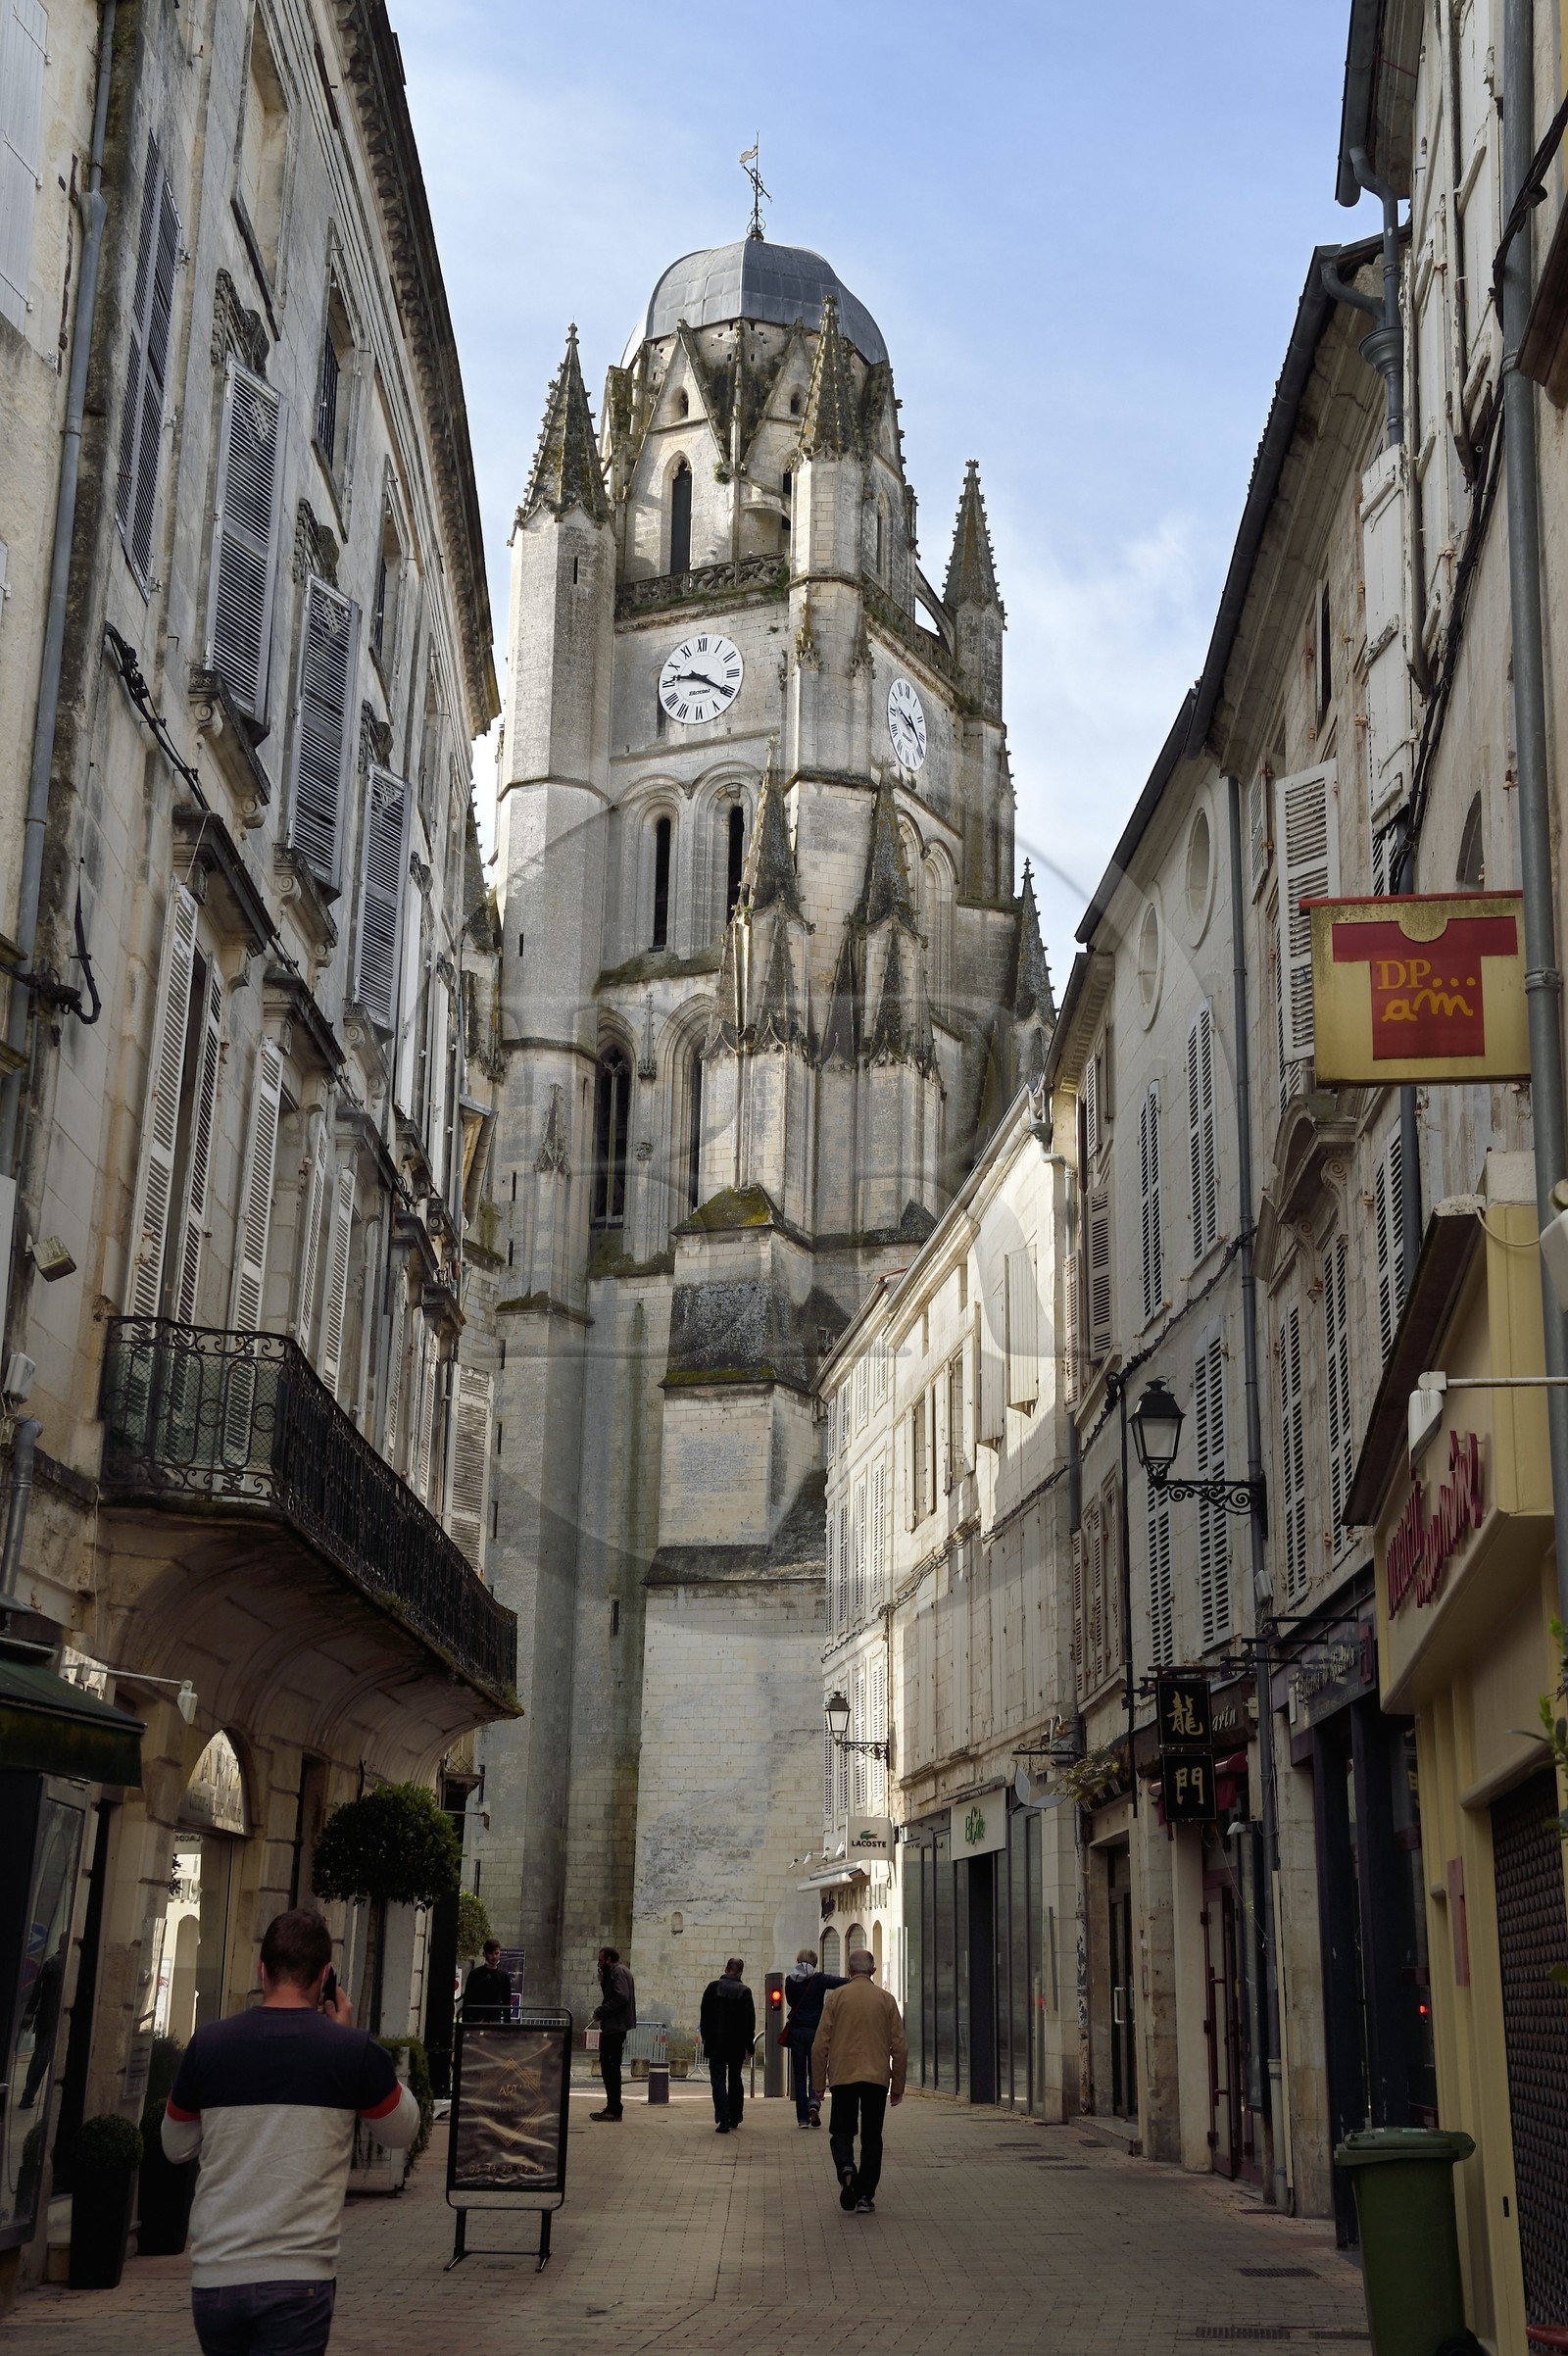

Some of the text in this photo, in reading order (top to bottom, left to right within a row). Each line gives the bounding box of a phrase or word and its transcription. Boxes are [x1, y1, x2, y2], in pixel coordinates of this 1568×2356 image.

[697, 637, 708, 653] XII
[680, 645, 692, 661] XI
[722, 651, 737, 663] II
[667, 661, 681, 671] X
[726, 668, 740, 678] III
[1381, 988, 1474, 1023] am
[1211, 1704, 1237, 1732] arin
[851, 1840, 887, 1848] LACOSTE
